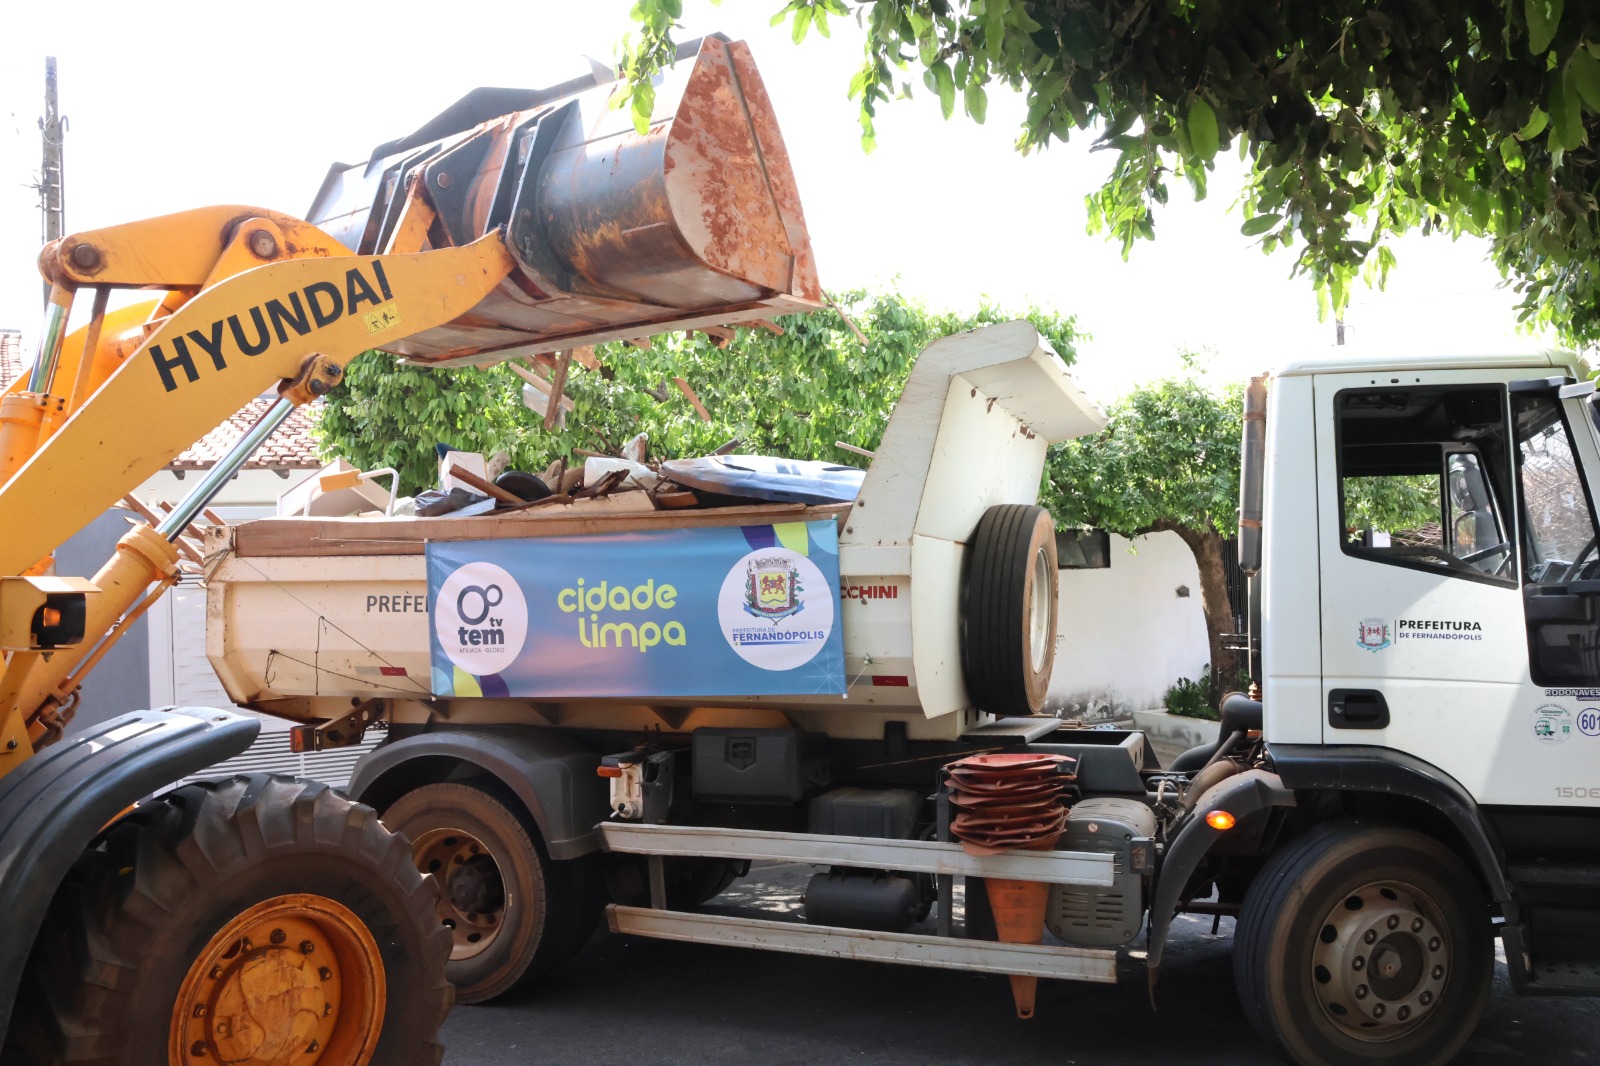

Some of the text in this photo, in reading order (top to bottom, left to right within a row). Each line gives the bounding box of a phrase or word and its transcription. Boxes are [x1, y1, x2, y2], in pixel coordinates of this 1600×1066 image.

[149, 259, 393, 392] HYUNDAI
[557, 577, 678, 613] cidade
[489, 617, 503, 627] tv
[1399, 620, 1482, 630] PREFEITURA
[458, 626, 505, 646] tem
[732, 630, 825, 641] FERNANDÓPOLIS
[1412, 632, 1482, 640] FERNANDÓPOLIS
